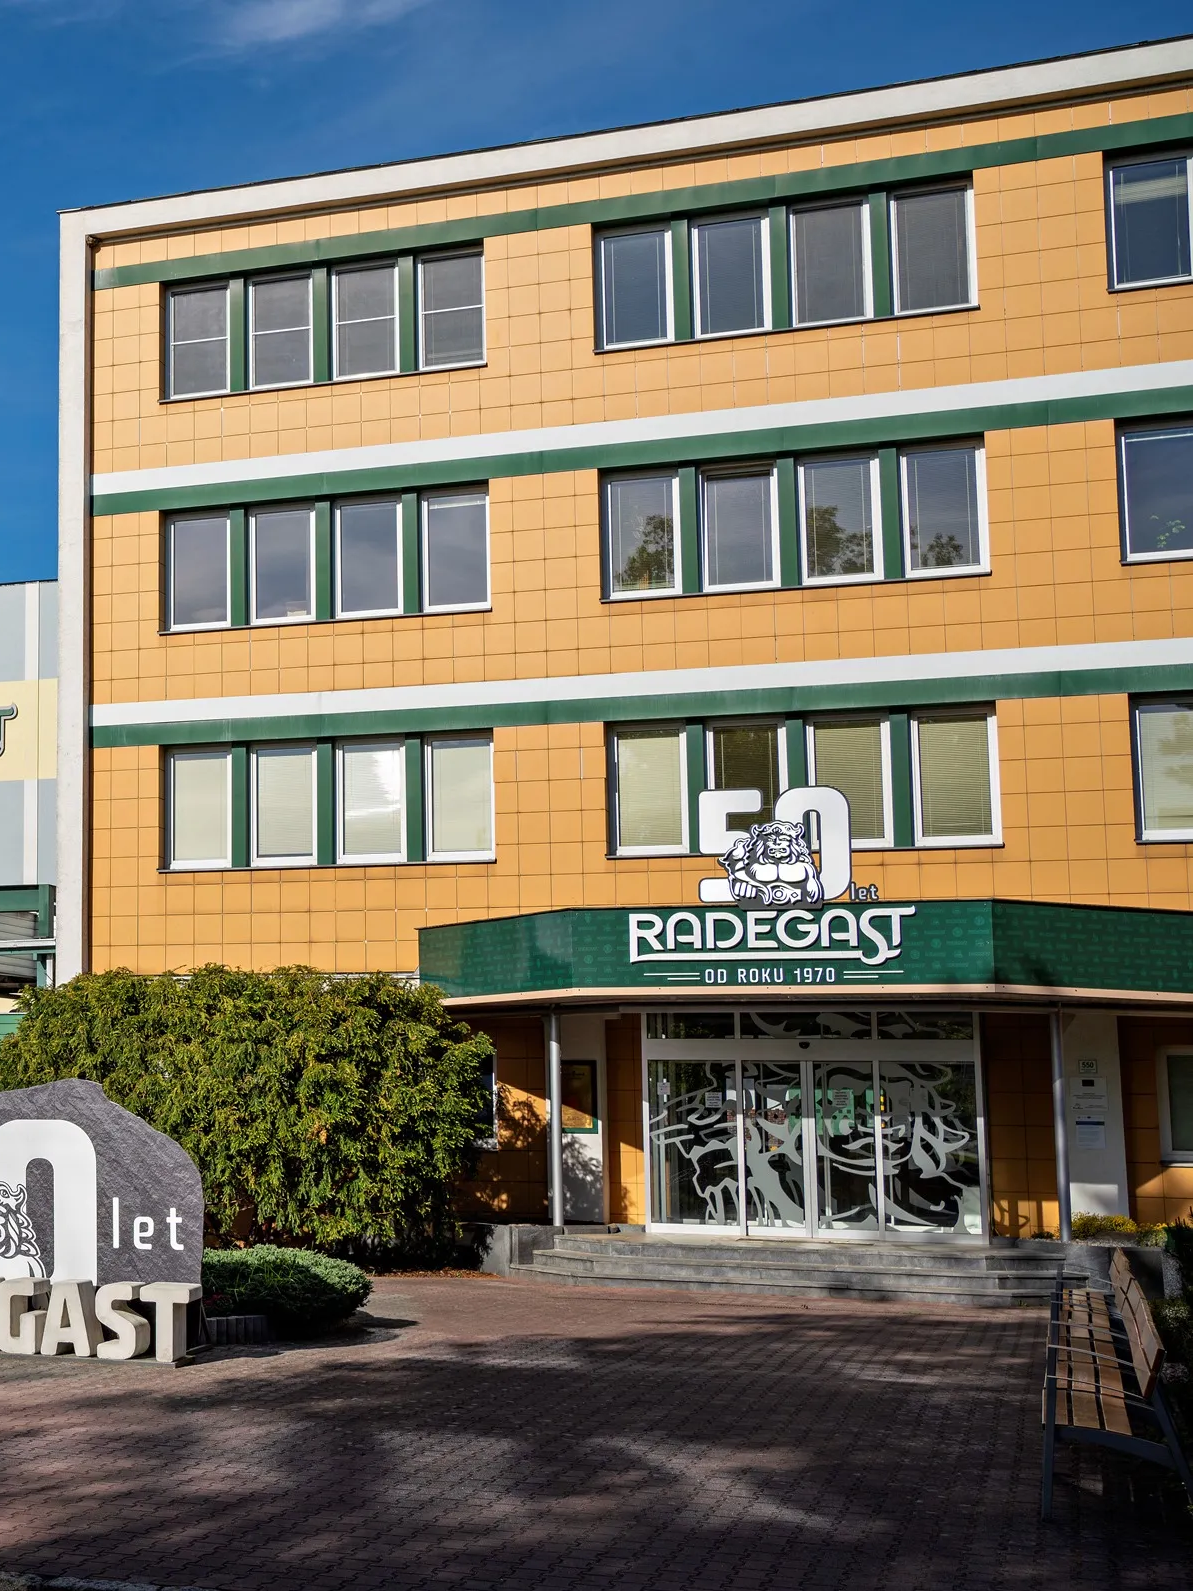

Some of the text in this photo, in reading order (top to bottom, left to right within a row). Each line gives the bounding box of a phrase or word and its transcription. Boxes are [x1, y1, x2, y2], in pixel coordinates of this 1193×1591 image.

[698, 785, 879, 903] 50 let
[629, 905, 916, 965] RADEGAST
[704, 967, 836, 984] OD ROKU 1970
[1081, 1061, 1094, 1069] 550
[112, 1197, 184, 1251] let
